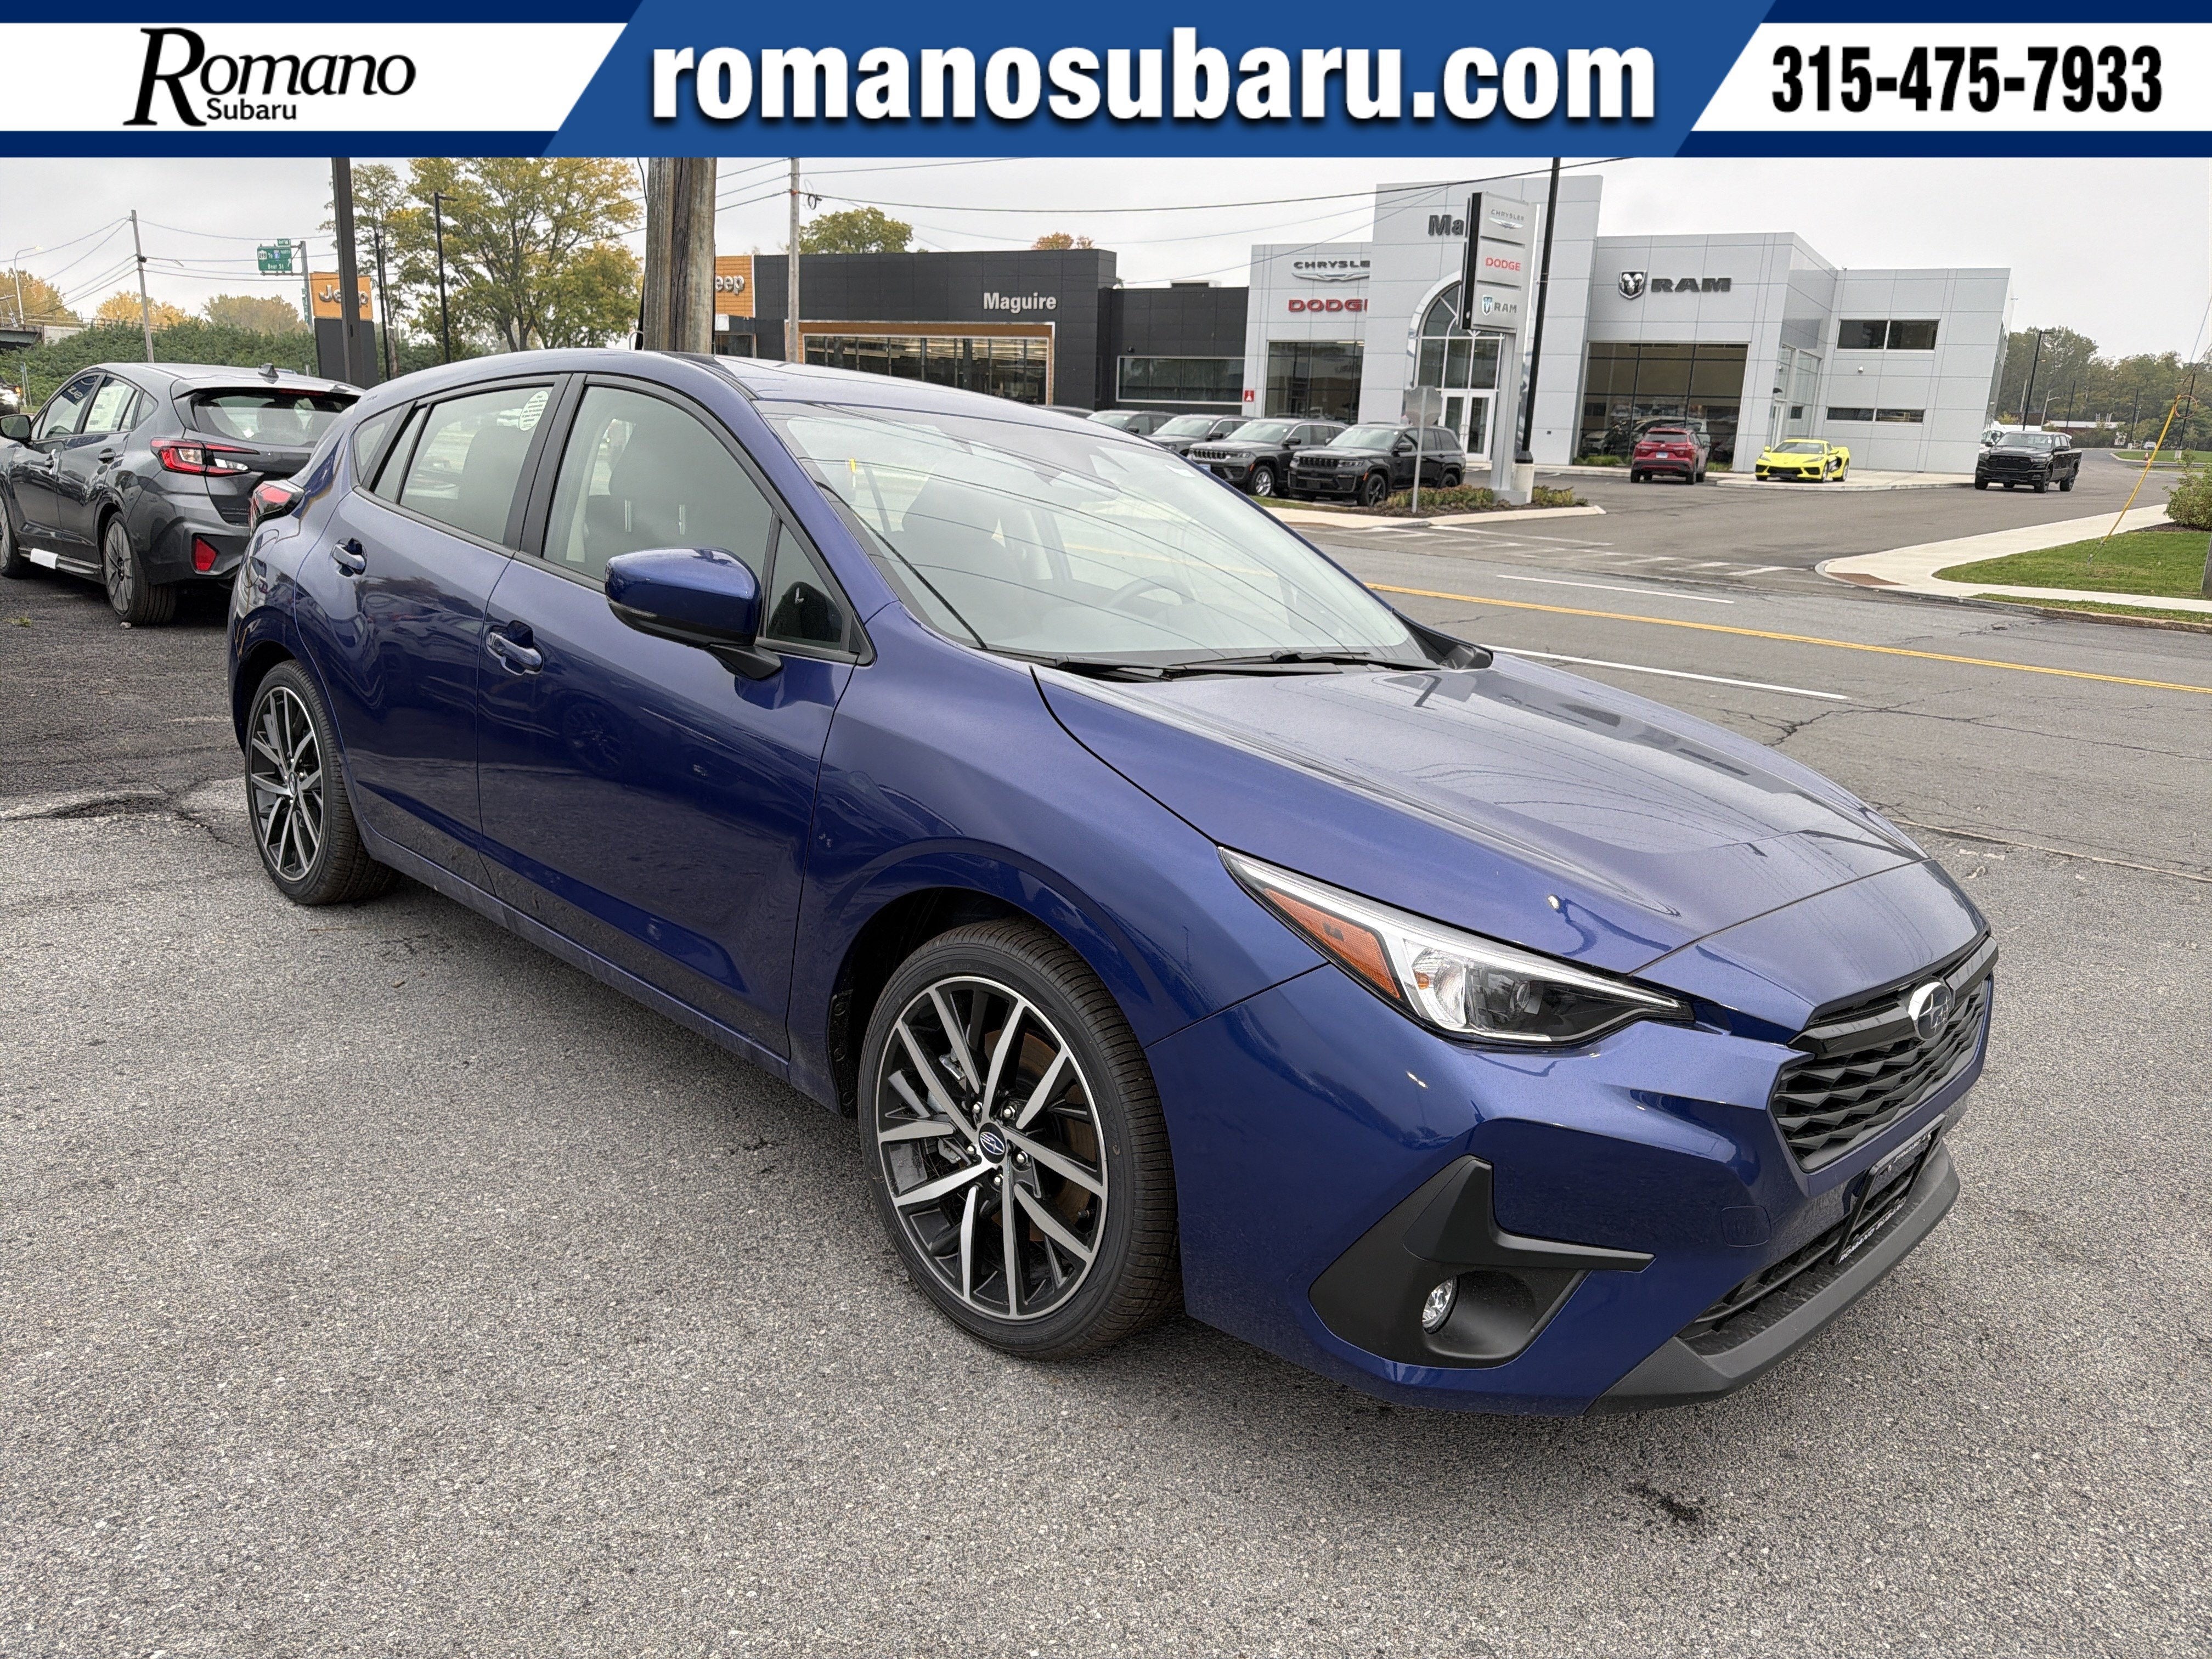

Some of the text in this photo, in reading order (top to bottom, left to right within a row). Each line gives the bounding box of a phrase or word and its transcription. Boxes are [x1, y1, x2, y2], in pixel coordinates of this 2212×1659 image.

[1491, 209, 1524, 221] CHRYSLER
[1294, 260, 1370, 269] CHRYSLE
[1486, 257, 1521, 271] DODGE
[715, 275, 744, 295] eep
[1650, 278, 1732, 292] RAM
[319, 284, 369, 308] Jep
[984, 292, 1057, 314] Maguire
[1288, 298, 1368, 313] DODG
[1494, 302, 1517, 314] RAM
